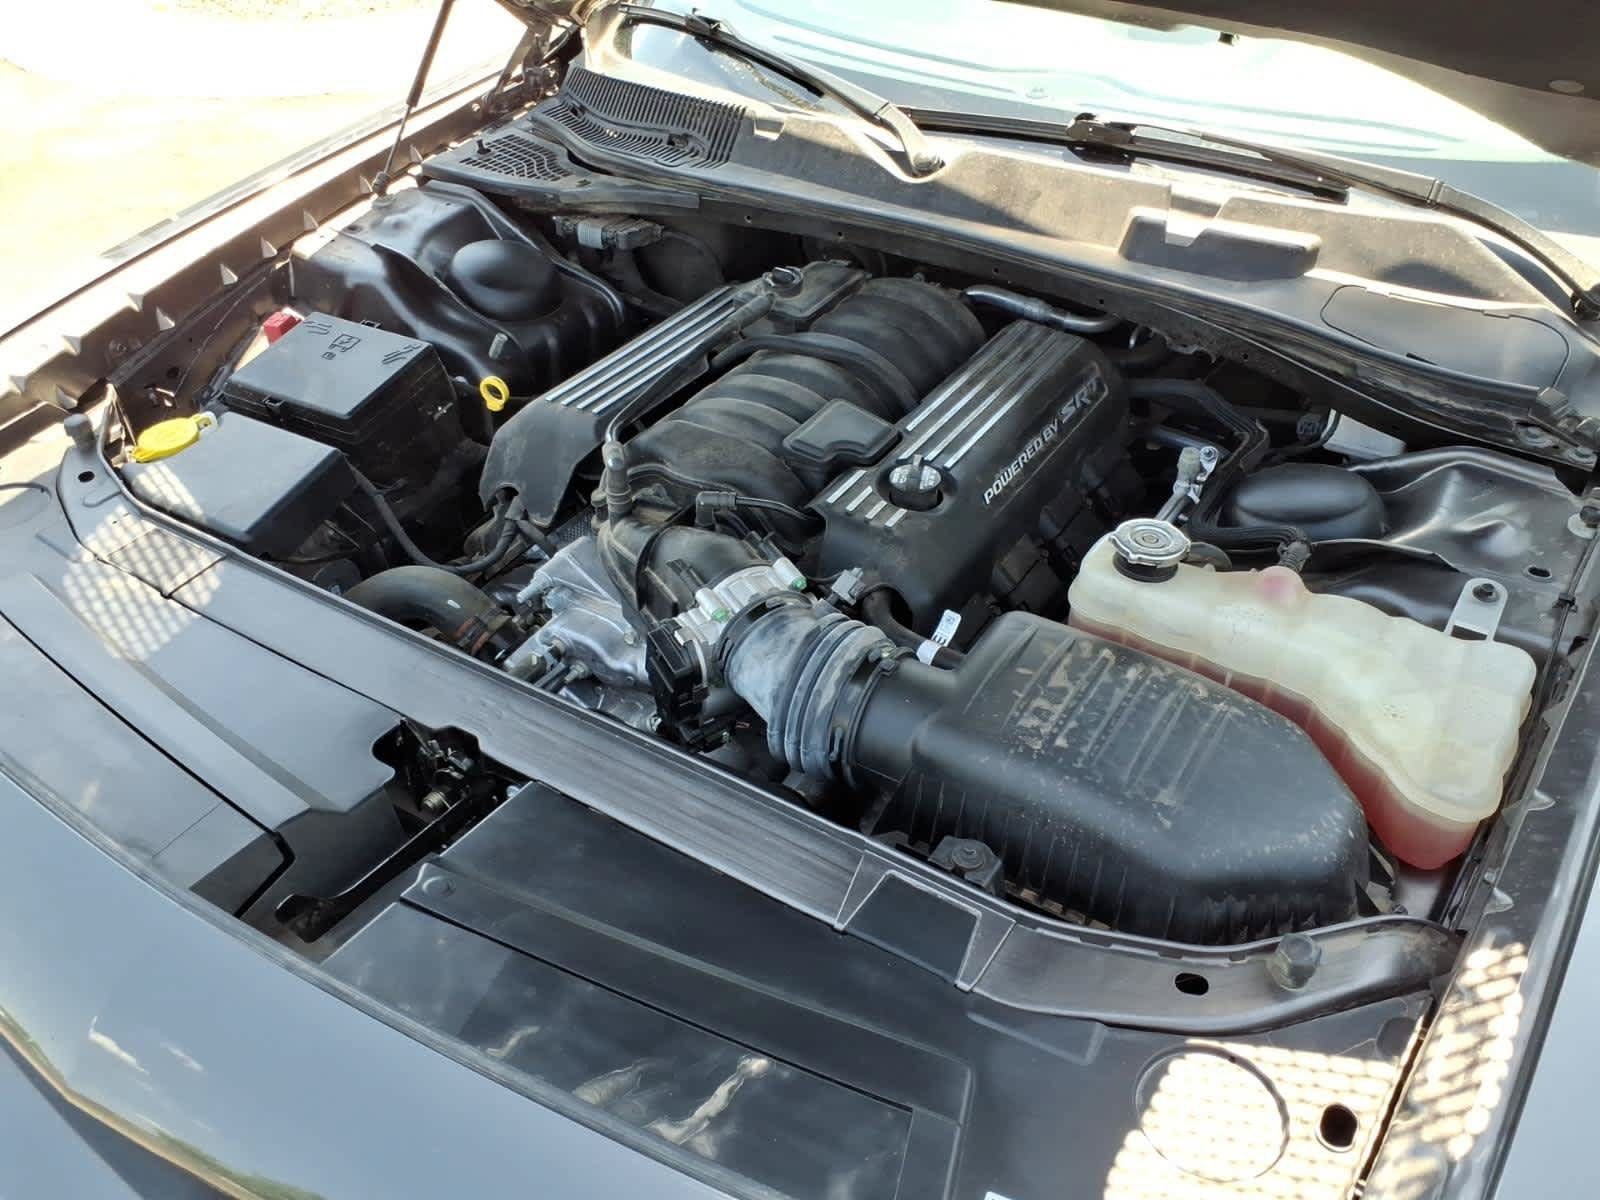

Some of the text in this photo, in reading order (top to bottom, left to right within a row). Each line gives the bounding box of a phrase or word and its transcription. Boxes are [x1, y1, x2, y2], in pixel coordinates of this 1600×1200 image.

[983, 377, 1099, 504] POWERED BY SRT
